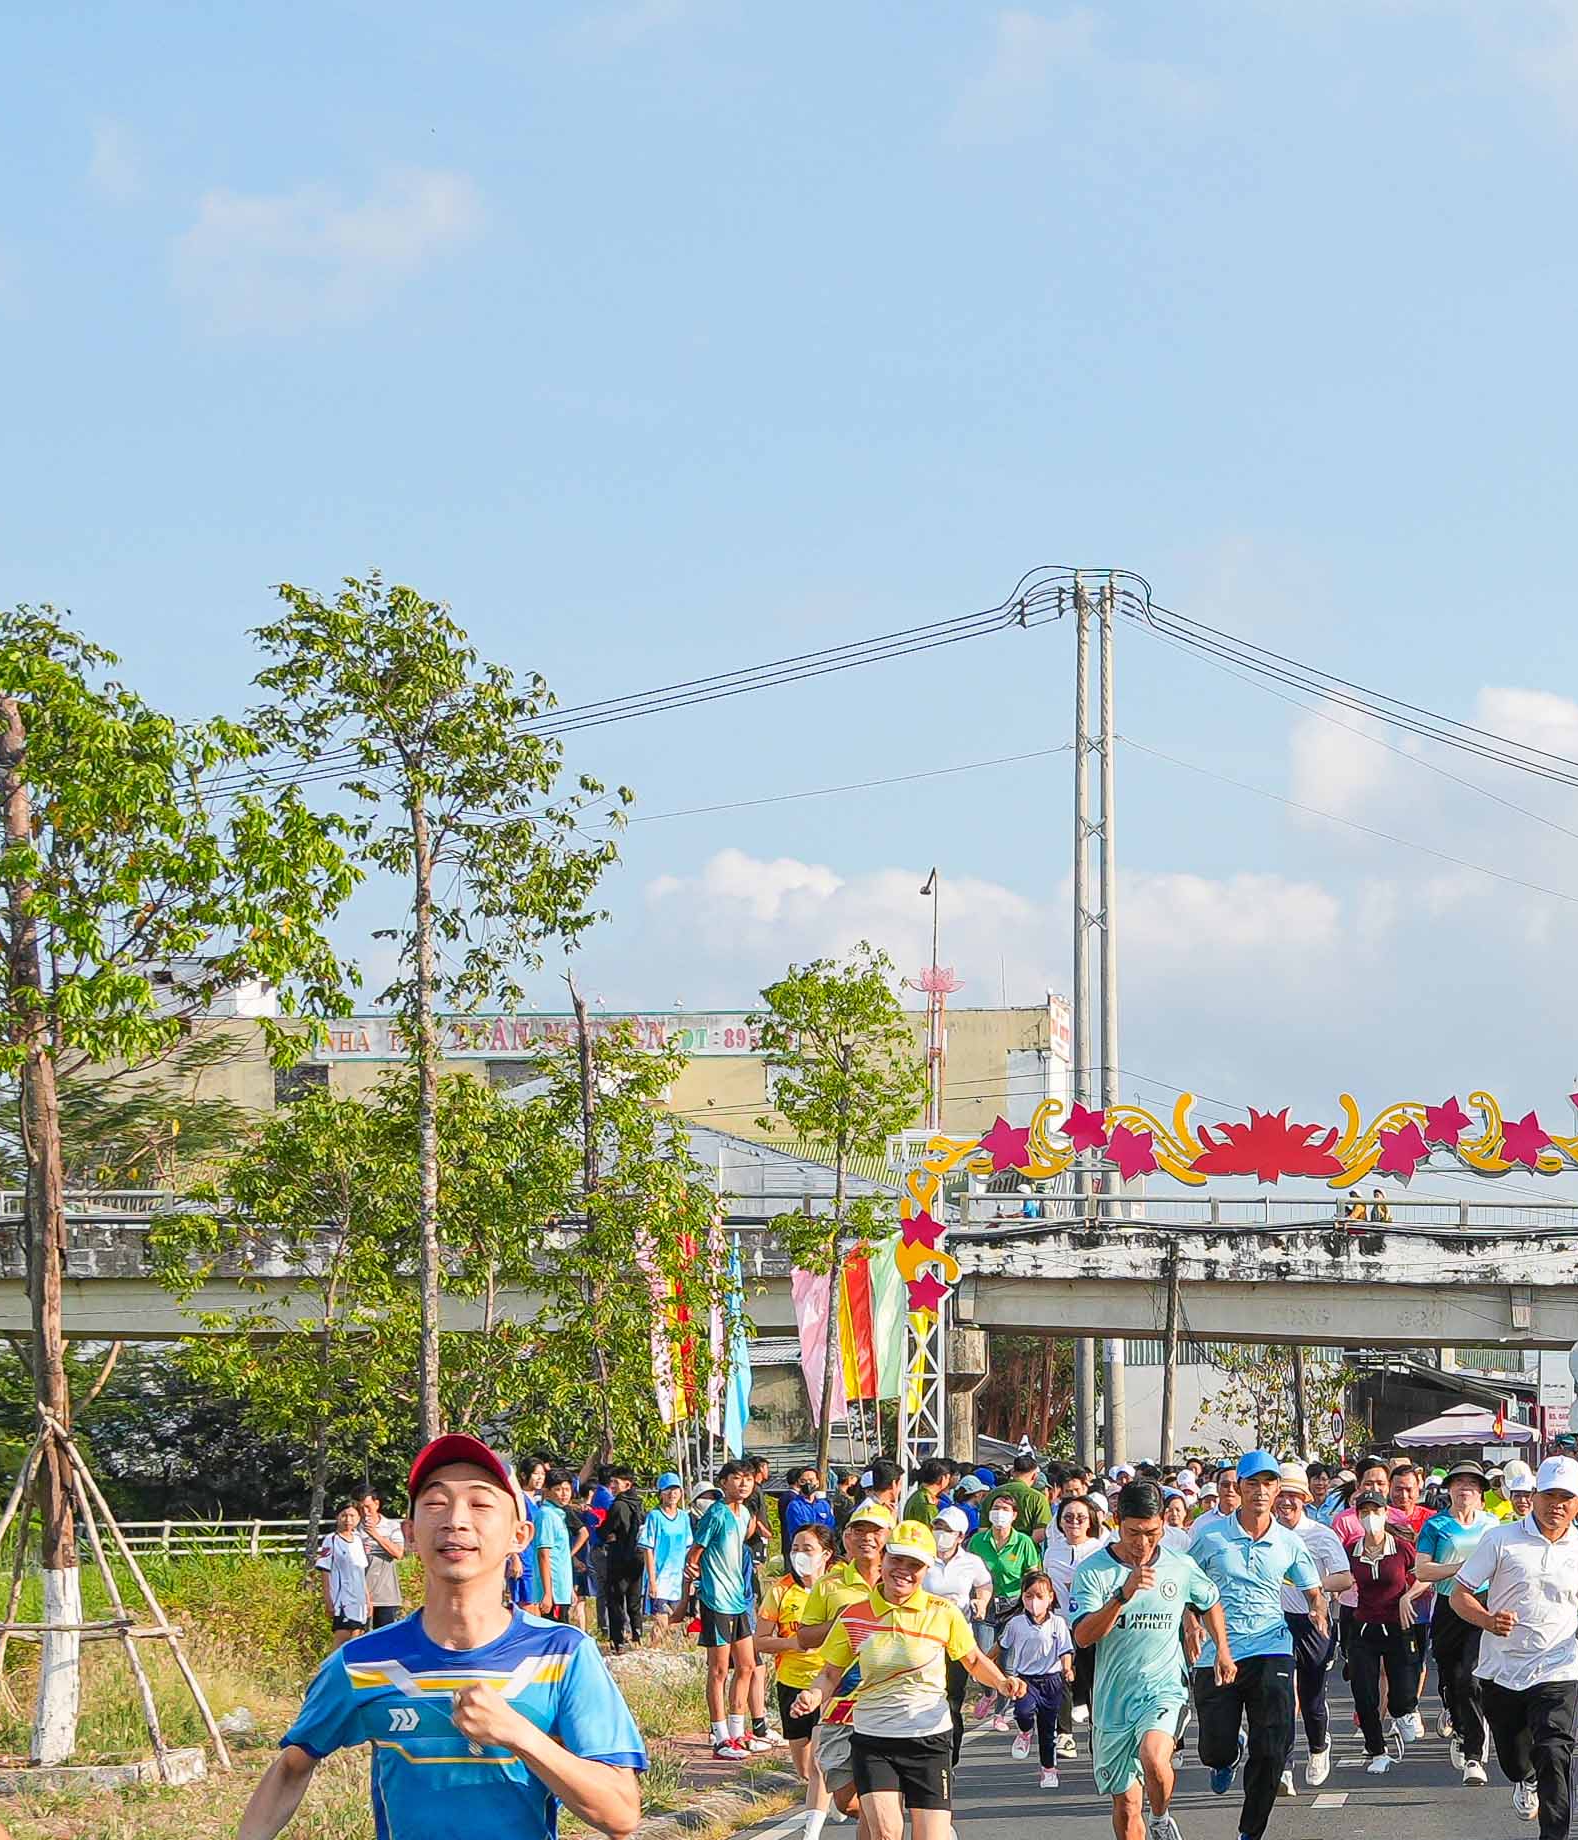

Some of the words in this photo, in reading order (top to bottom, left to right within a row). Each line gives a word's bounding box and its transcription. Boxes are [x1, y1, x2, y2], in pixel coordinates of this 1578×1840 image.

[320, 1025, 371, 1052] NHÀ
[1131, 1613, 1173, 1621] INFINITE
[1129, 1622, 1172, 1630] ATHLETE
[1156, 1707, 1169, 1720] 7
